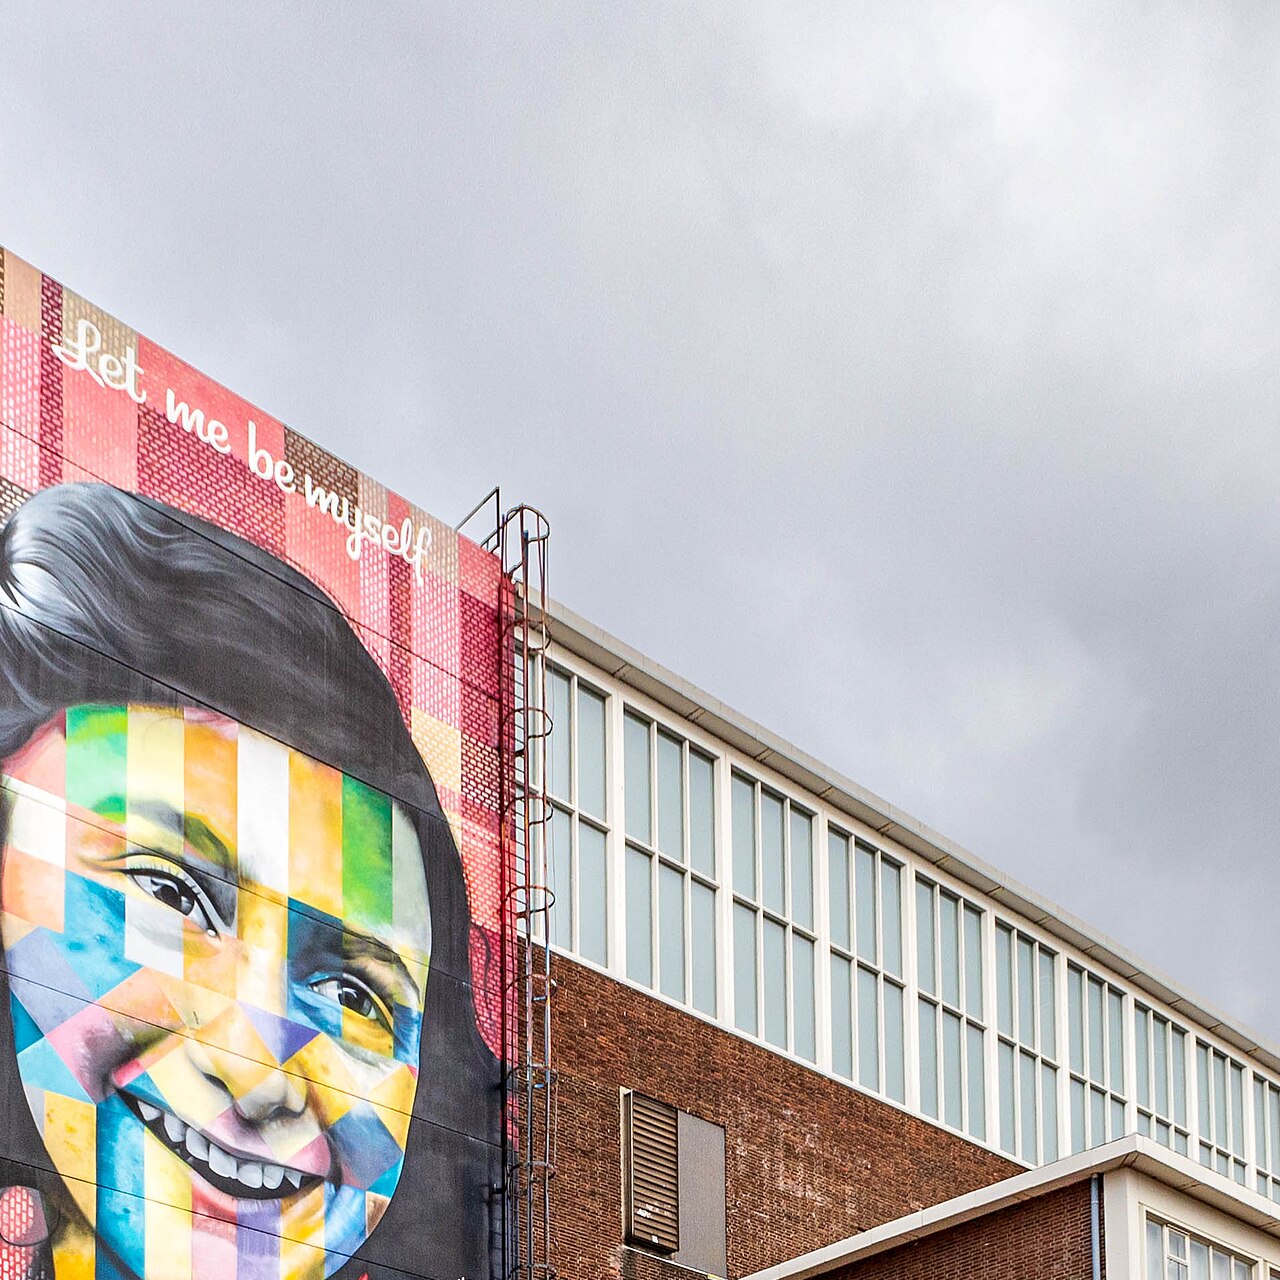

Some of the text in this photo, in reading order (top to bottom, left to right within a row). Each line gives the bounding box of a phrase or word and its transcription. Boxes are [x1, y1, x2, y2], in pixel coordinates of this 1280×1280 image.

[51, 319, 432, 584] Let me be myself
